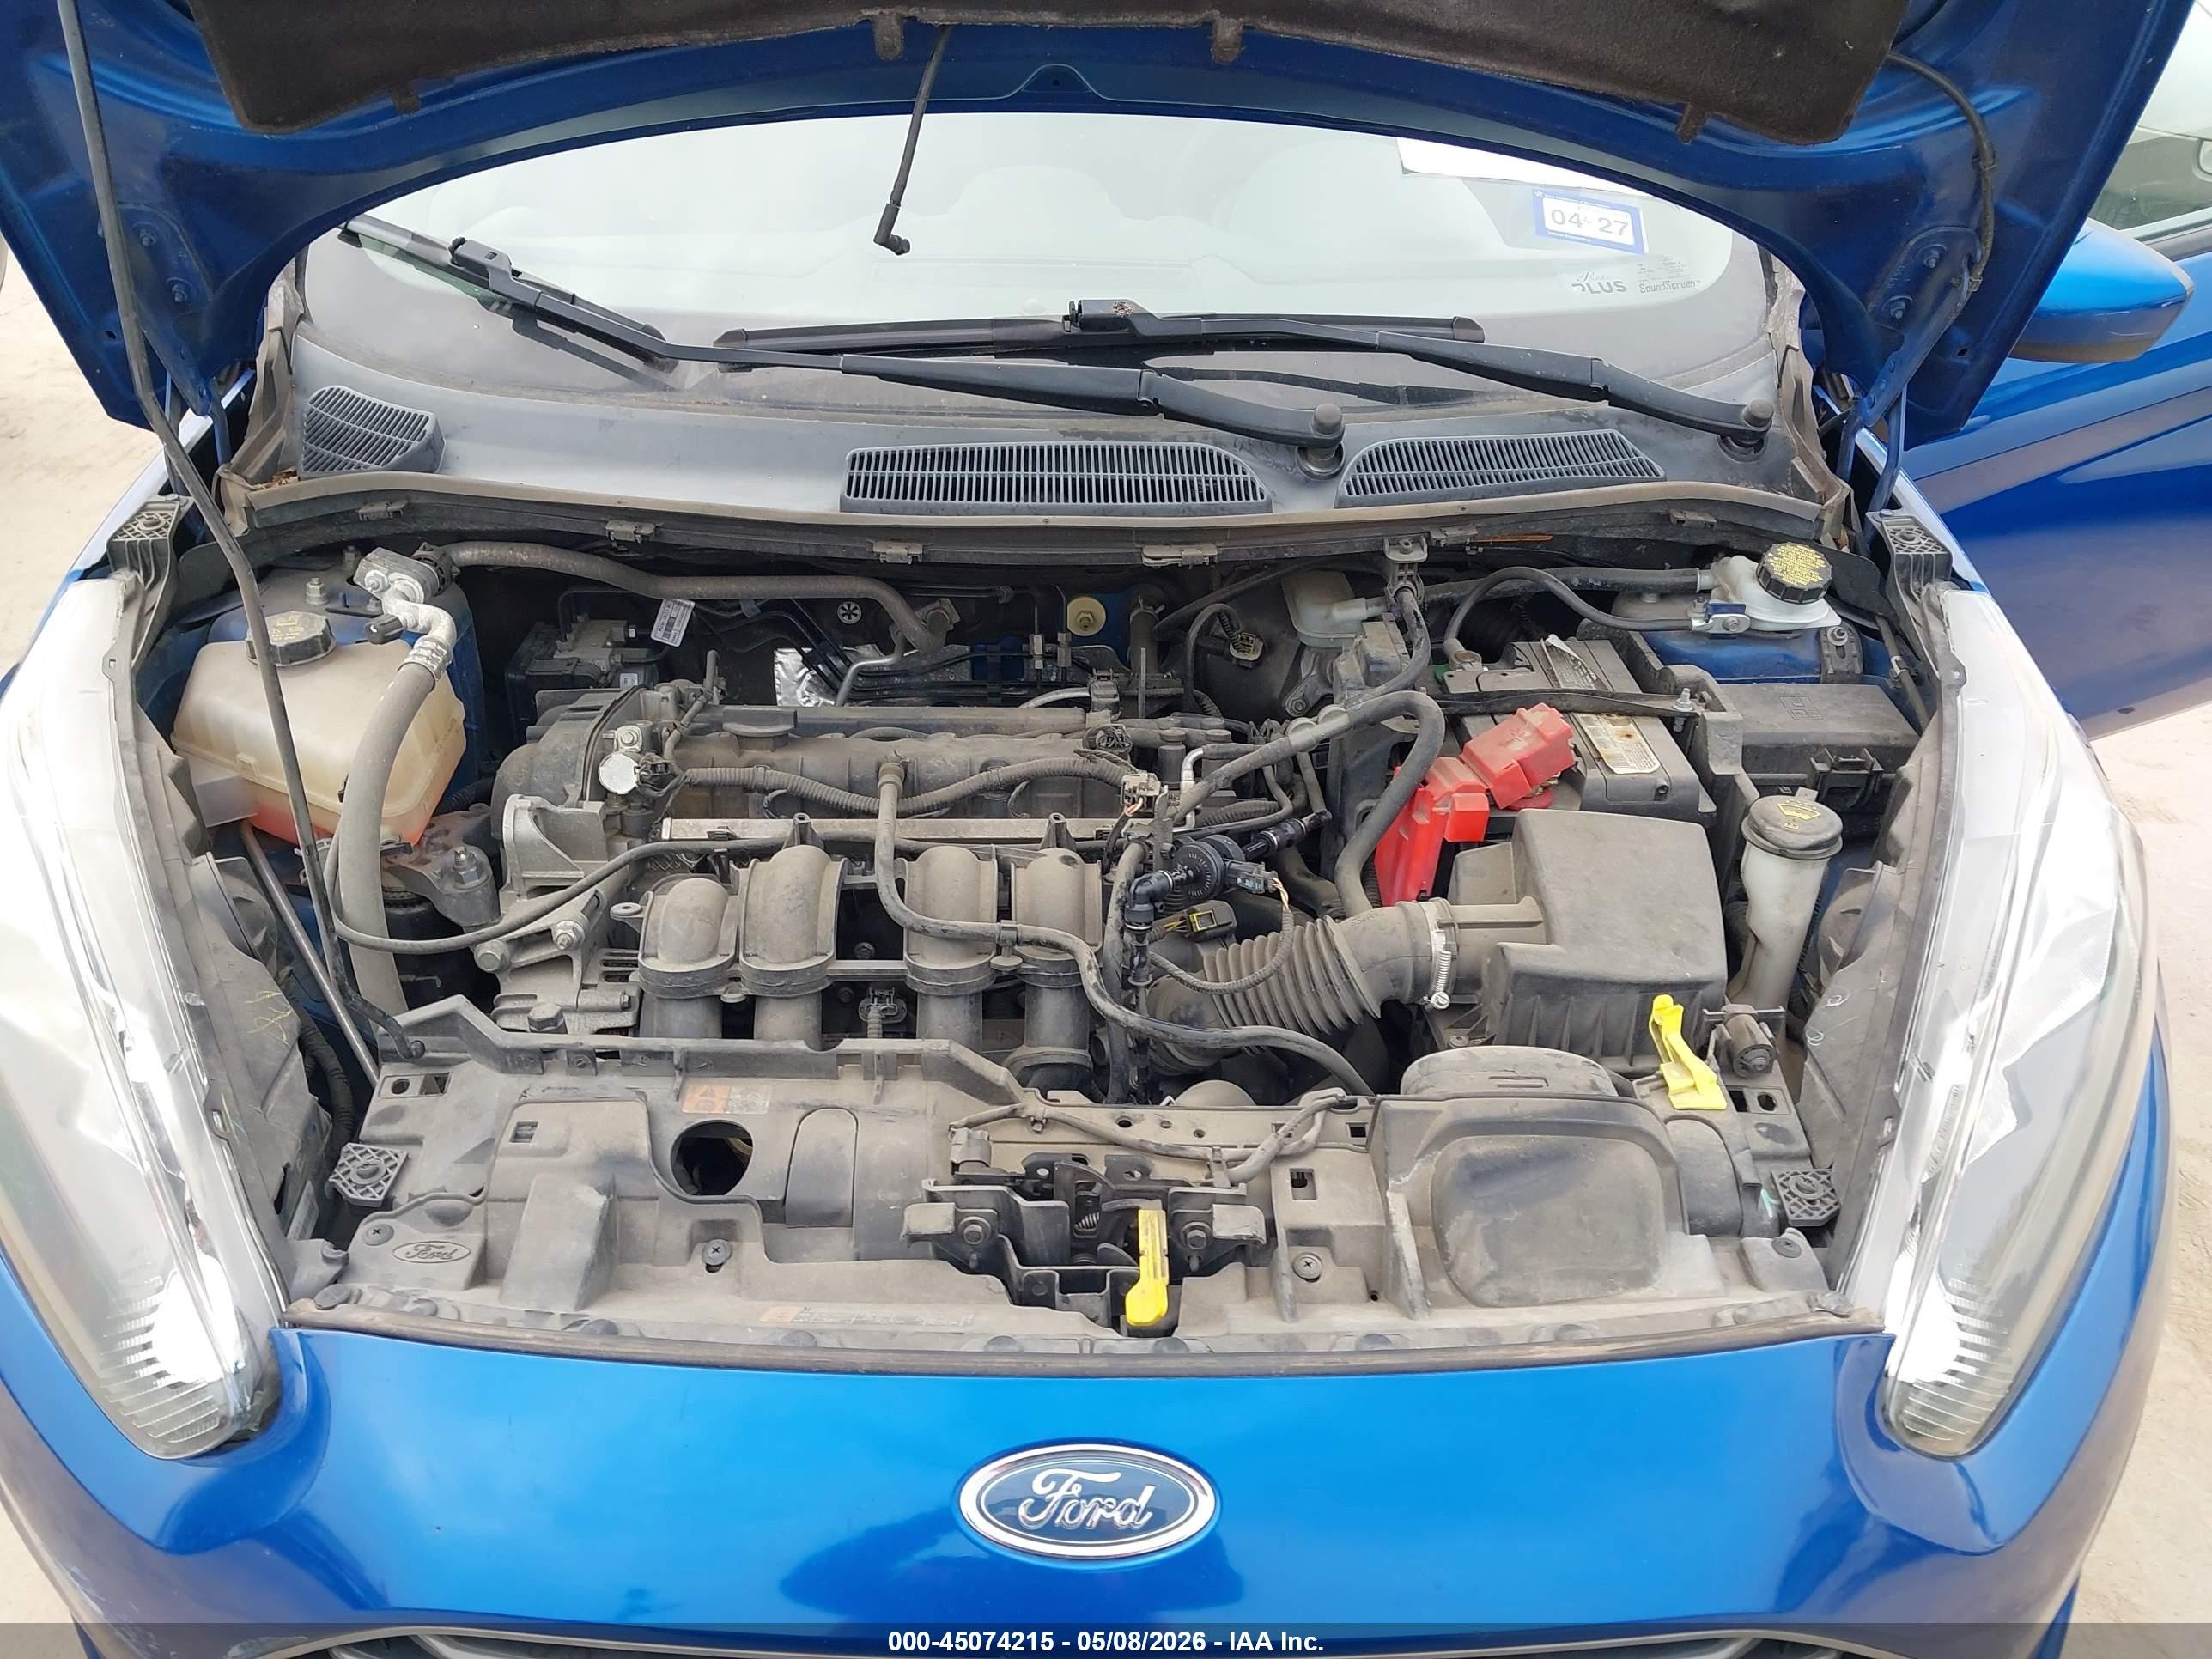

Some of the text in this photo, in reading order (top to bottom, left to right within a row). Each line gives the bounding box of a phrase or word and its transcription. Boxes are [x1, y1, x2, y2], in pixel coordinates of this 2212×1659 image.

[1551, 209, 1582, 228] 04
[1597, 216, 1629, 236] 27
[404, 1243, 458, 1260] Ford
[1018, 1468, 1156, 1530] Ford
